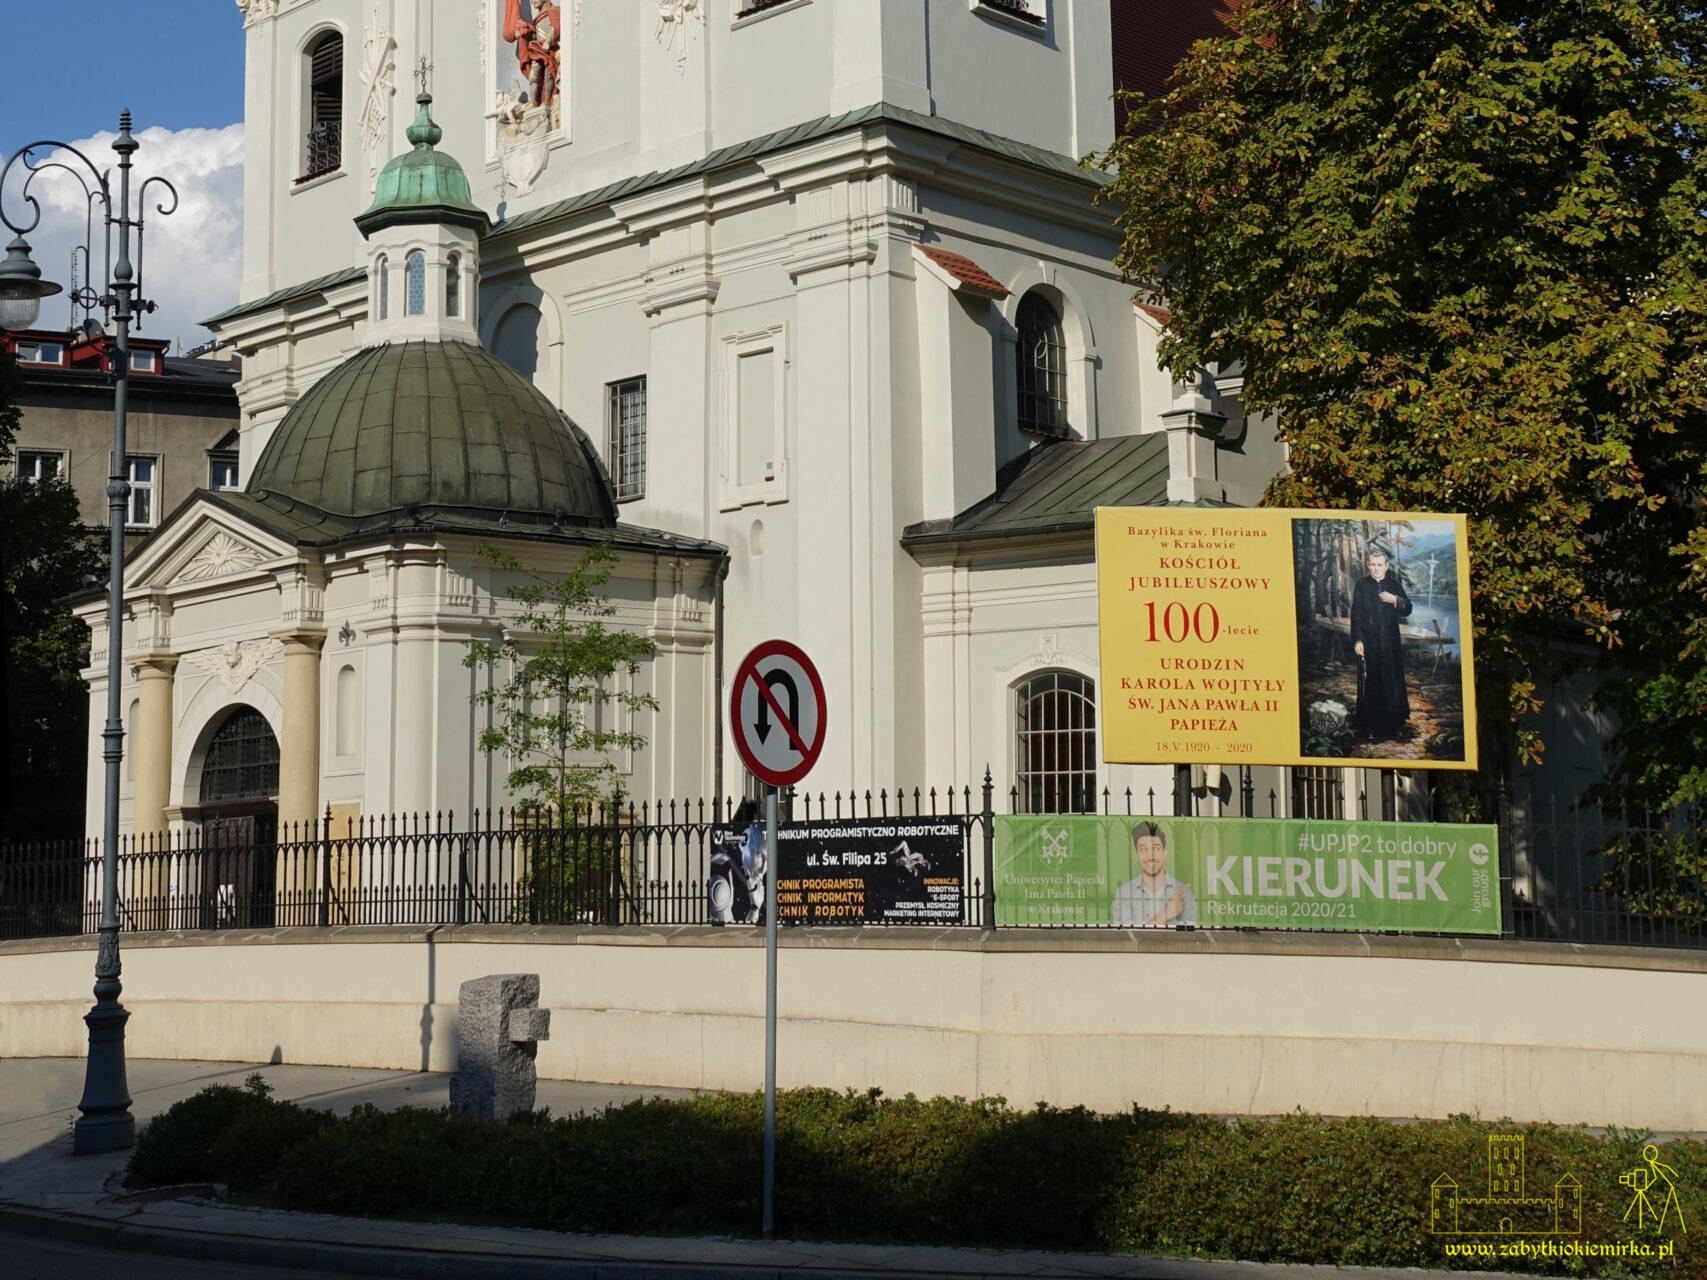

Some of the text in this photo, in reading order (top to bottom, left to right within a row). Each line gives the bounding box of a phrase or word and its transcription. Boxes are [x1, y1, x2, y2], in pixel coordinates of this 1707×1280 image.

[1128, 526, 1267, 539] Bazylika św. Floriana
[1161, 539, 1235, 550] w Krakowie
[1159, 554, 1240, 570] KOŚCIÓŁ
[1128, 576, 1271, 591] JUBILEUSZOWY
[1160, 658, 1245, 671] URODZIN
[1121, 677, 1285, 694] KAROLA WOJTYŁY
[1128, 696, 1279, 713] ŚW. JANA PAWŁA II
[1170, 716, 1238, 732] PAPIEŻA
[1156, 741, 1210, 753] 18.V.1920
[1226, 742, 1253, 753] 2020
[763, 825, 959, 841] THNIKUM PROGRAMISTYCZNO ROBOTYCZNE
[1298, 833, 1457, 859] #UPJP2 to dobry
[807, 850, 887, 866] ul. Św. Filipa 25
[777, 879, 864, 889] CHNIK PROGRAMISTA
[1004, 874, 1105, 888] Uniwersytet Papieski
[1206, 855, 1449, 902] KIERUNEK
[1472, 868, 1480, 887] our
[1023, 888, 1086, 900] Jana Pawła II
[1480, 868, 1492, 908] groups
[777, 892, 864, 903] CHNIK INFORMATYK
[777, 905, 864, 916] CHNIK ROBOTYK
[1028, 903, 1085, 914] w Krakowie
[1207, 900, 1356, 918] Rekrutacja 2020/21
